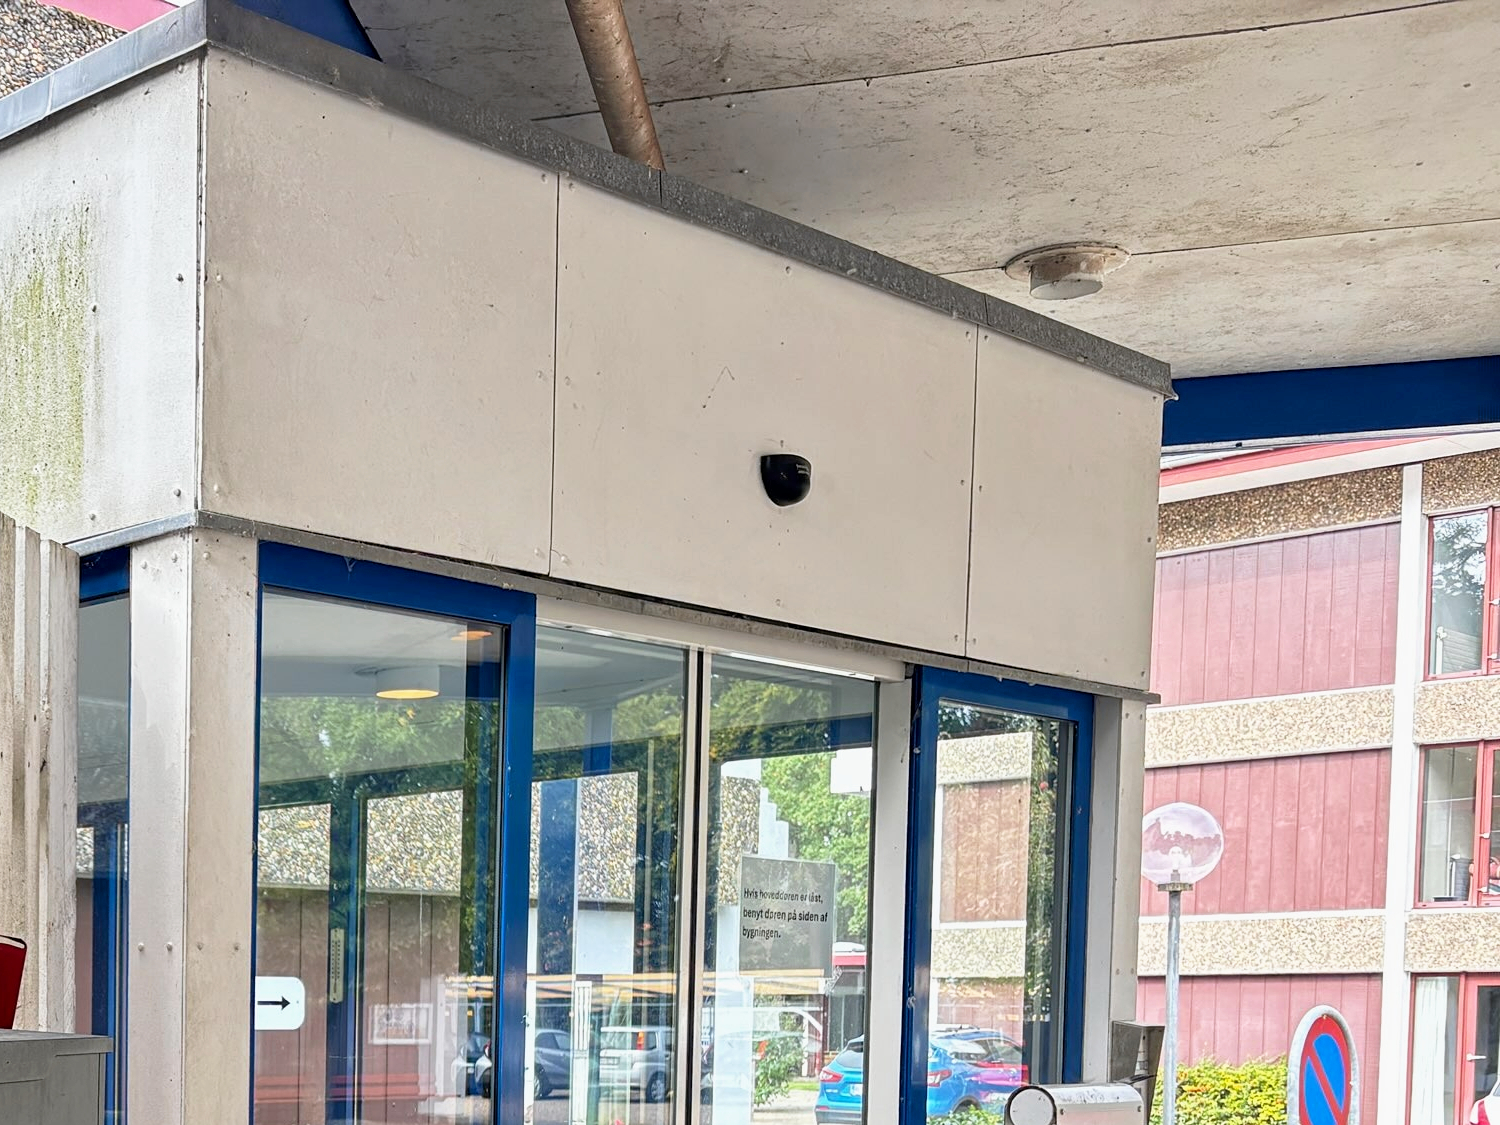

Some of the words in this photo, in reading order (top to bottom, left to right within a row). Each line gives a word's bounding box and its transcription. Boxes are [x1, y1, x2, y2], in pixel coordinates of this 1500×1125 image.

[743, 887, 759, 899] Hvis
[759, 888, 799, 901] hoveddøren
[800, 894, 808, 902] er
[808, 891, 824, 904] låst,
[743, 907, 763, 921] benyt
[764, 908, 786, 920] døren
[787, 909, 797, 923] på
[798, 911, 819, 922] siden
[819, 912, 828, 922] af
[742, 925, 782, 941] bygningen.
